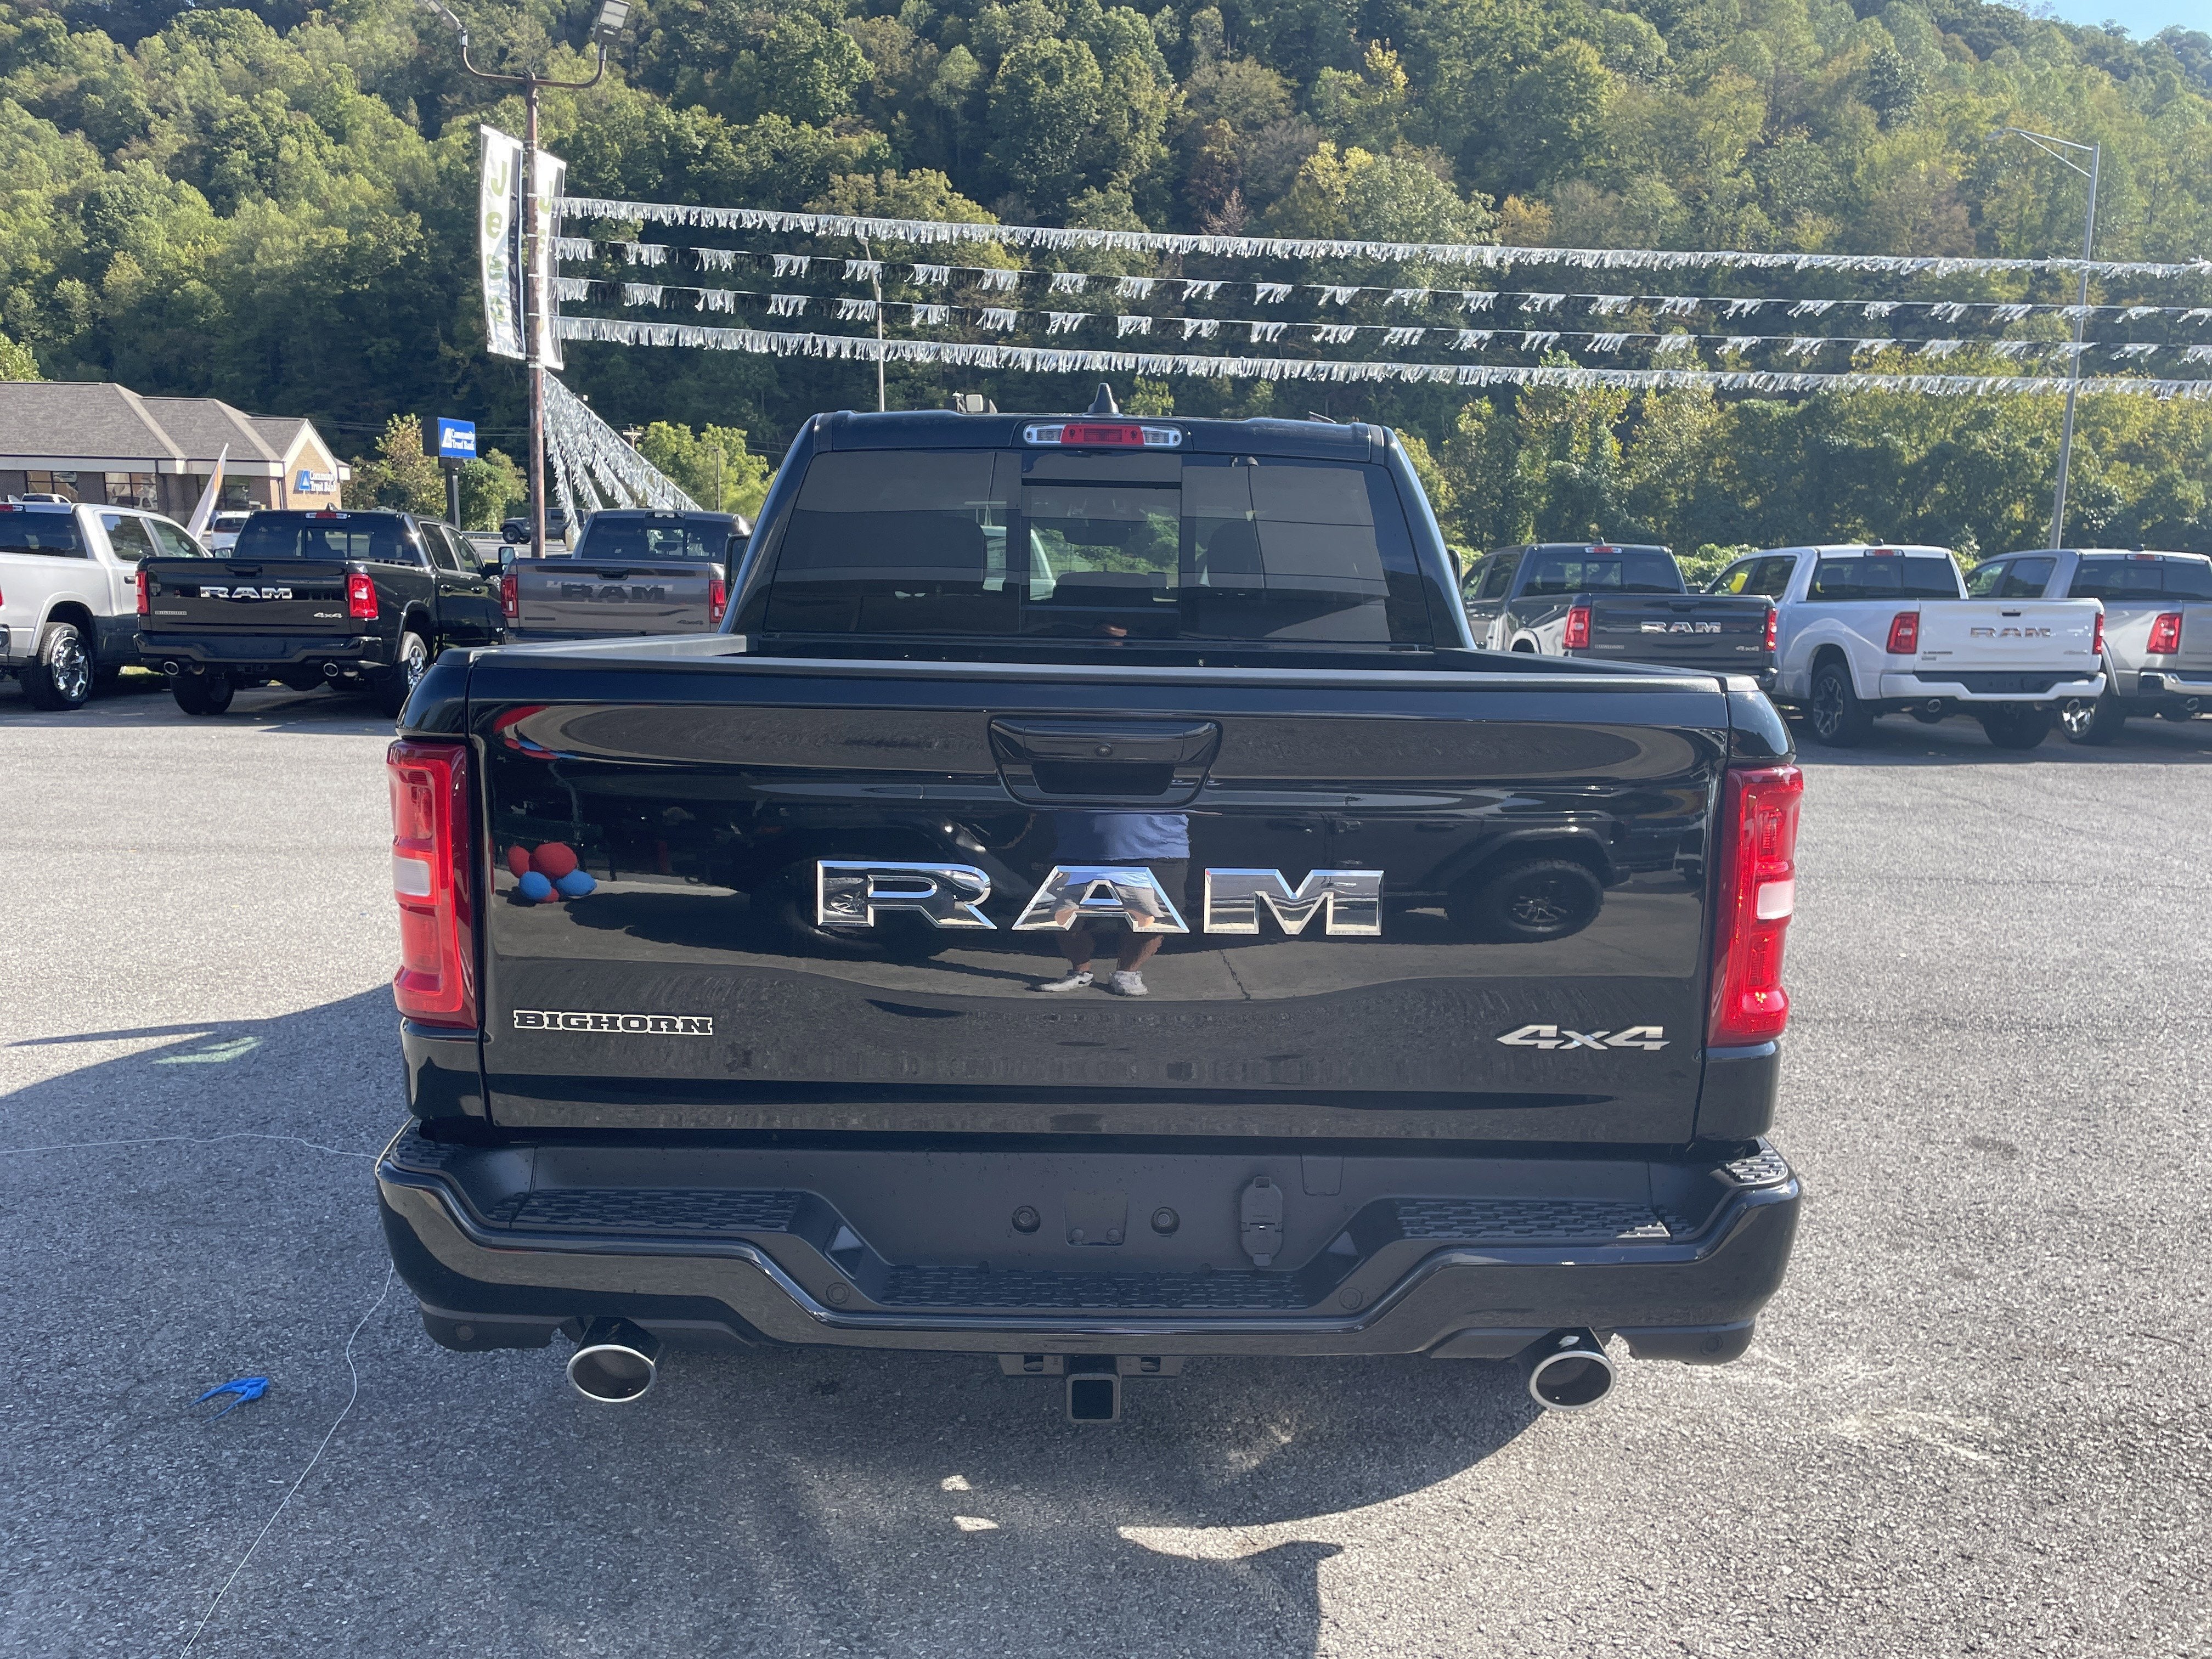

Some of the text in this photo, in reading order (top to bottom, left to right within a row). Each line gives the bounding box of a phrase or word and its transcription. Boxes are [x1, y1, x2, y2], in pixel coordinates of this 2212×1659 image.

[200, 586, 292, 599] RAM
[561, 584, 665, 600] RAM
[1641, 621, 1722, 633] RAM
[1971, 627, 2051, 637] RAM
[817, 860, 1384, 936] RAM
[513, 1009, 713, 1036] BIGHORN
[1496, 1024, 1671, 1051] 4x4
